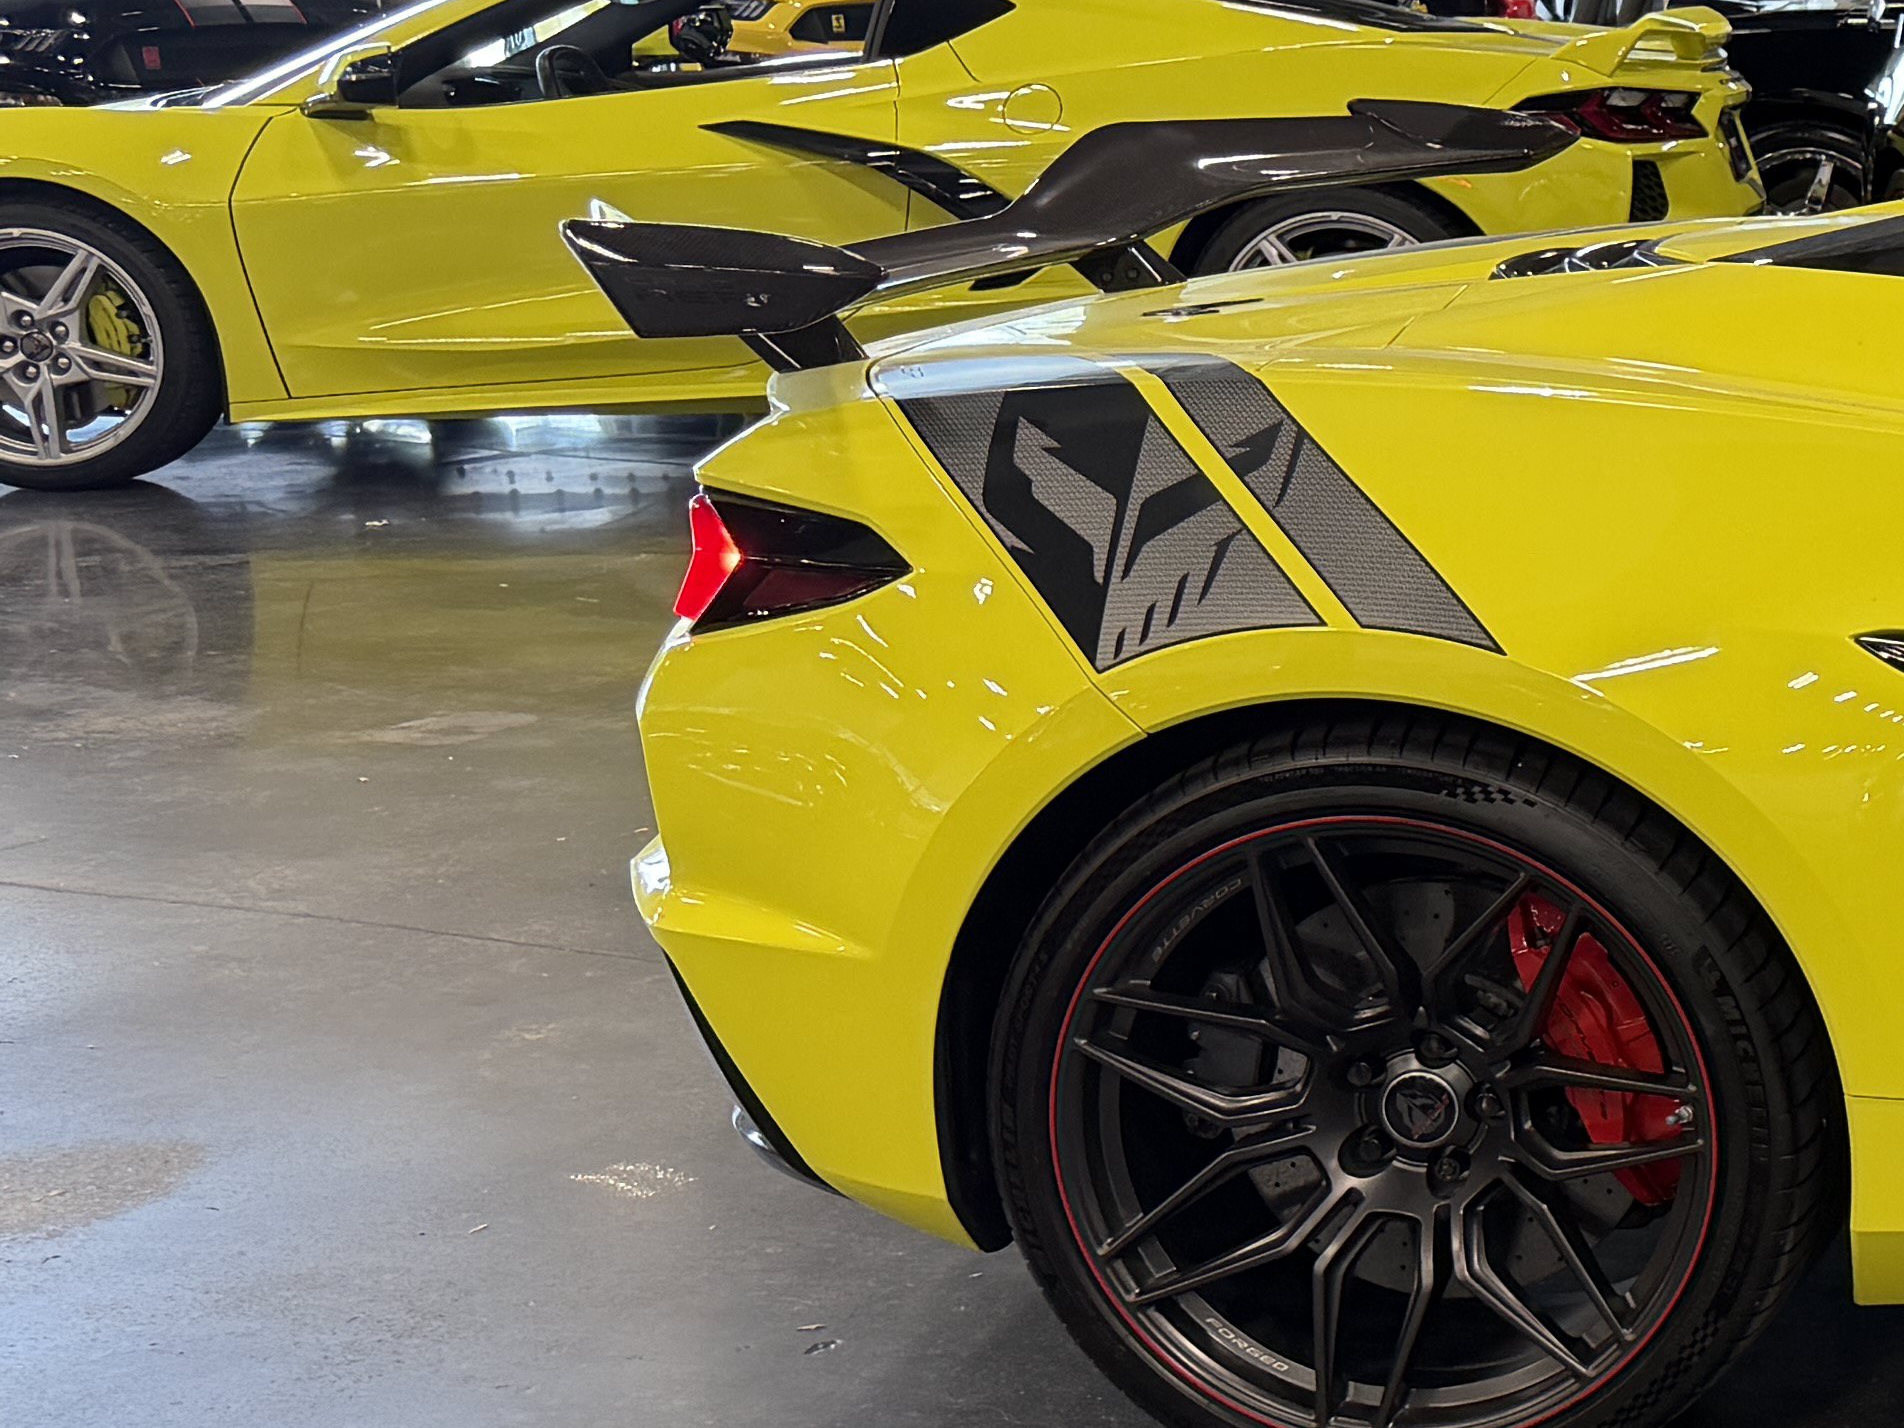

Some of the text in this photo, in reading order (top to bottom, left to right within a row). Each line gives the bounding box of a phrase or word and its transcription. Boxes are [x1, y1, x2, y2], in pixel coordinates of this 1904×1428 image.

[1151, 876, 1243, 964] CORVETTE
[1714, 993, 1770, 1163] MICHELIN
[1204, 1316, 1290, 1373] FORGED
